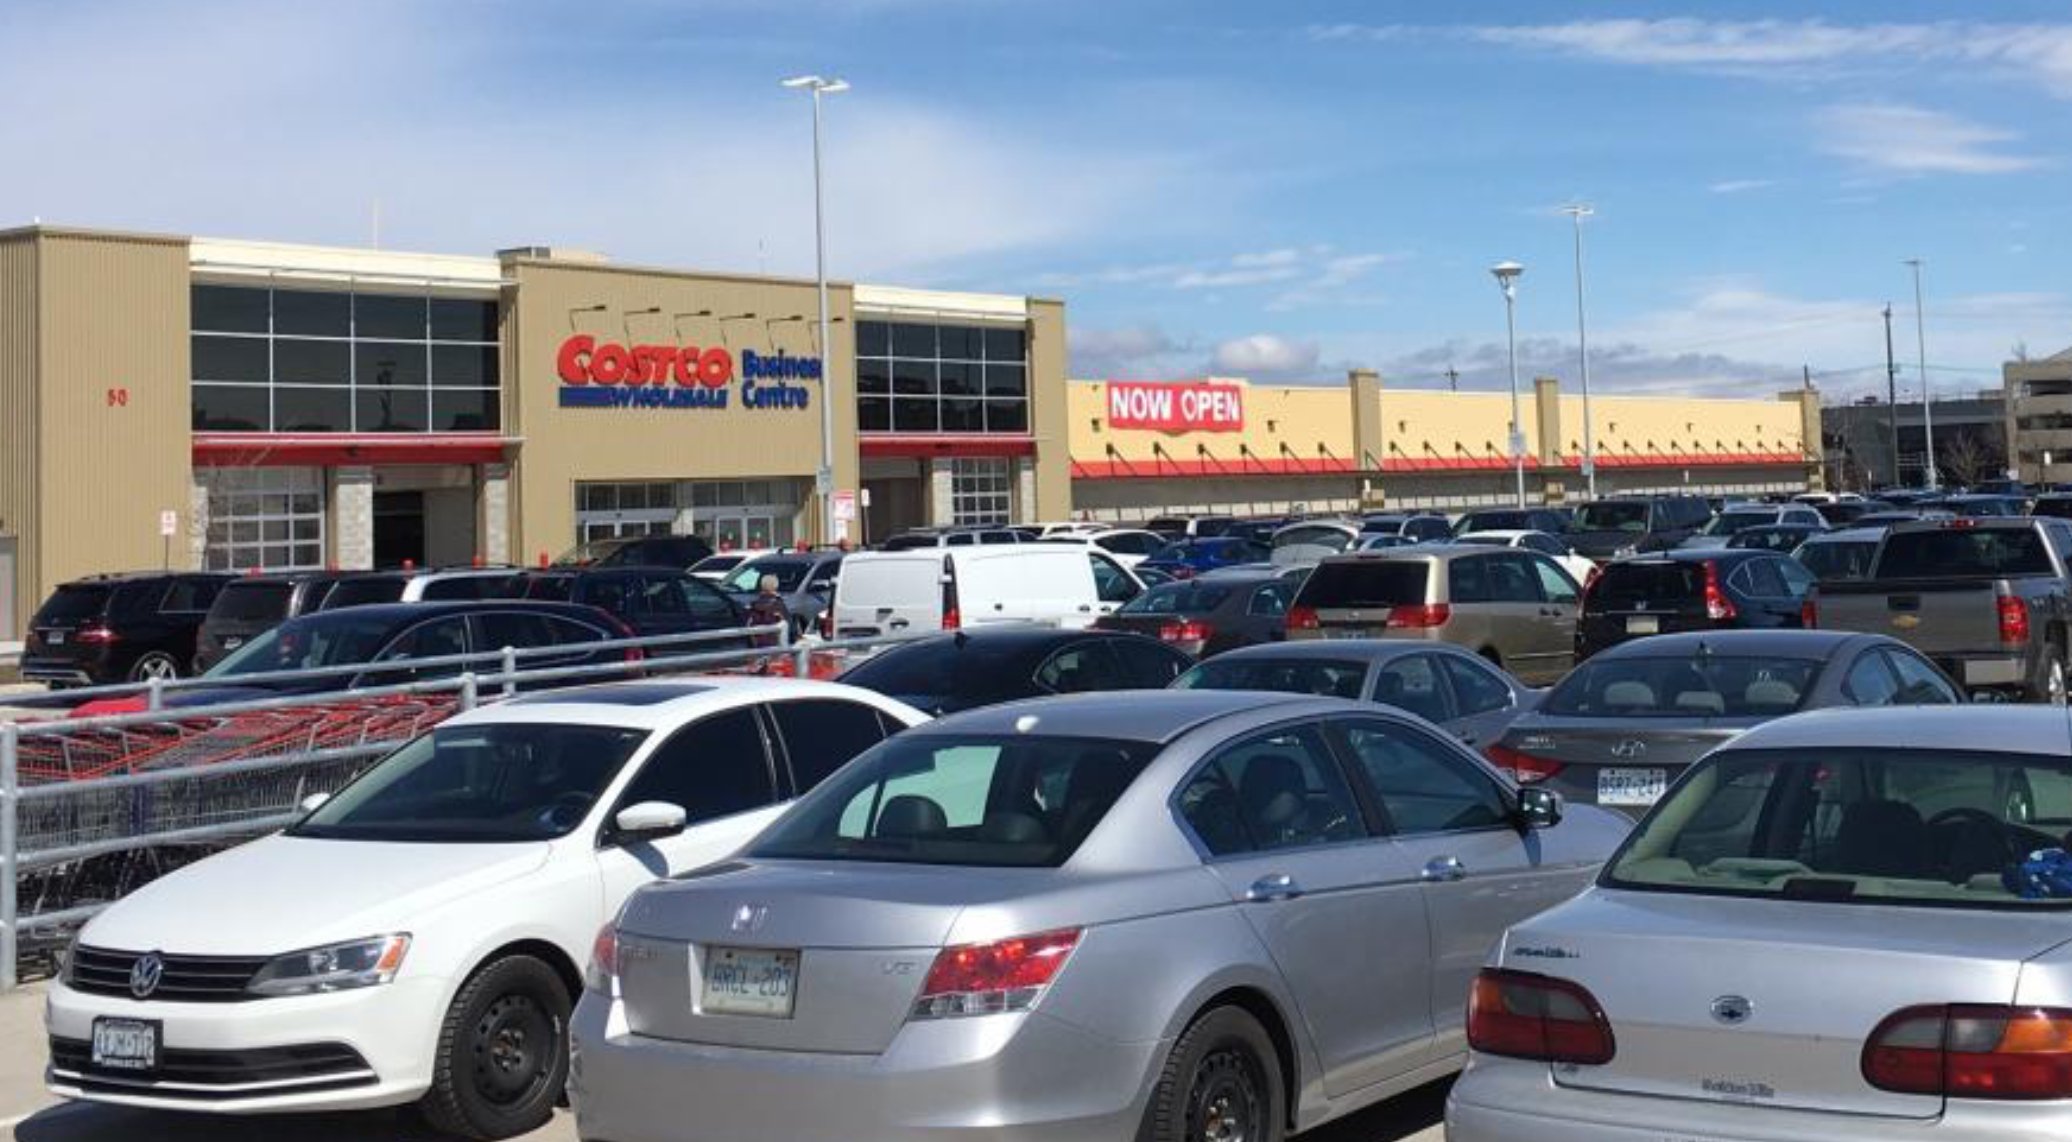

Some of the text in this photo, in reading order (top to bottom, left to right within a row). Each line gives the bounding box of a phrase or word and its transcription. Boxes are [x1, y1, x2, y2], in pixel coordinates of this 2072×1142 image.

[557, 334, 732, 387] COSTCO
[742, 349, 823, 380] Busines
[742, 379, 809, 410] Centre
[1110, 386, 1240, 422] NOW OPEN
